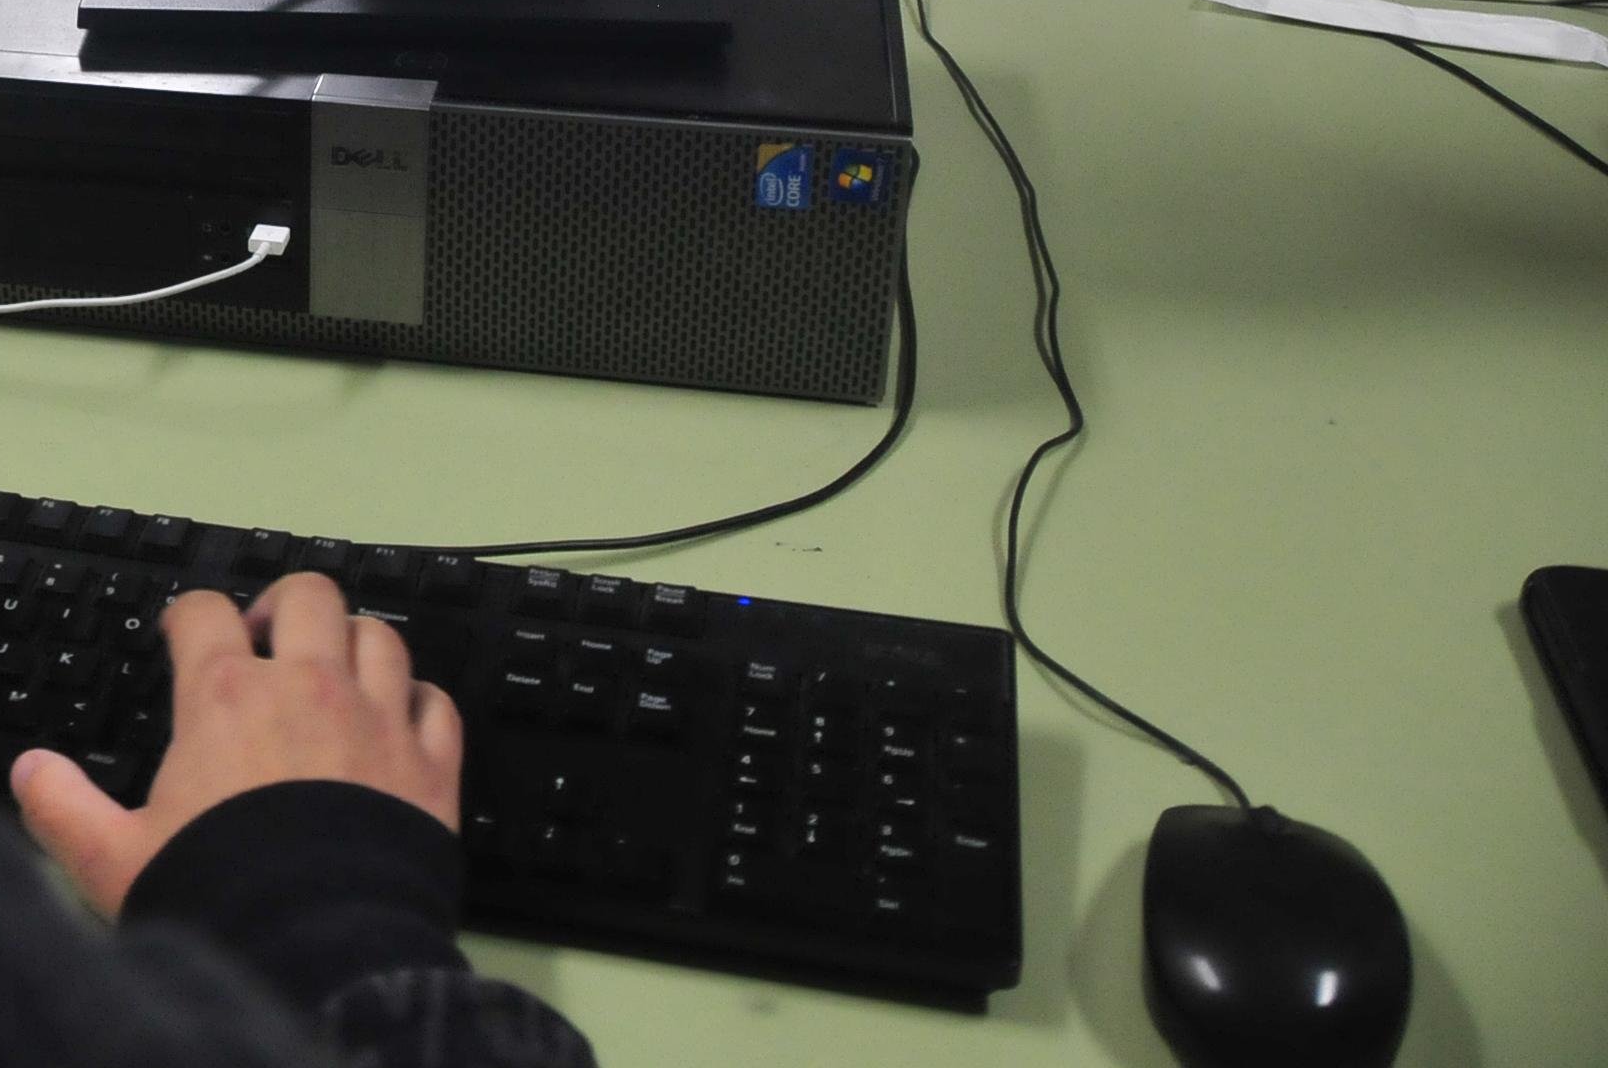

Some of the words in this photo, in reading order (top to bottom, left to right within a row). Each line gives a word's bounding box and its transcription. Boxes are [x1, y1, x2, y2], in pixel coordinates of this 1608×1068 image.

[331, 145, 408, 172] DELL
[787, 174, 802, 208] CORE
[42, 499, 55, 509] F6
[100, 508, 113, 517] F7
[156, 516, 170, 526] F8
[255, 531, 269, 541] F9
[314, 538, 336, 549] F10
[375, 547, 396, 557] F11
[437, 555, 459, 566] F12
[591, 584, 615, 594] Lock
[656, 584, 687, 595] Pause
[4, 598, 19, 611] U
[654, 594, 684, 605] Break
[63, 608, 71, 620] I
[124, 617, 141, 630] O
[515, 628, 545, 641] Insert
[581, 639, 613, 651] Home
[58, 651, 75, 666] K
[647, 647, 673, 659] Page
[646, 655, 663, 665] Up
[749, 662, 776, 672] Num
[505, 672, 541, 686] Delete
[748, 670, 775, 681] Lock
[572, 682, 595, 694] End
[640, 692, 668, 703] Page
[638, 700, 672, 712] Down
[745, 706, 756, 717] 7
[815, 716, 826, 728] 8
[743, 725, 777, 737] Home
[884, 725, 895, 737] 9
[740, 754, 752, 765] 4
[811, 763, 822, 775] 5
[882, 773, 894, 786] 6
[808, 813, 819, 826] 2
[733, 822, 757, 835] End
[954, 833, 989, 849] Enter
[727, 853, 741, 866] 0
